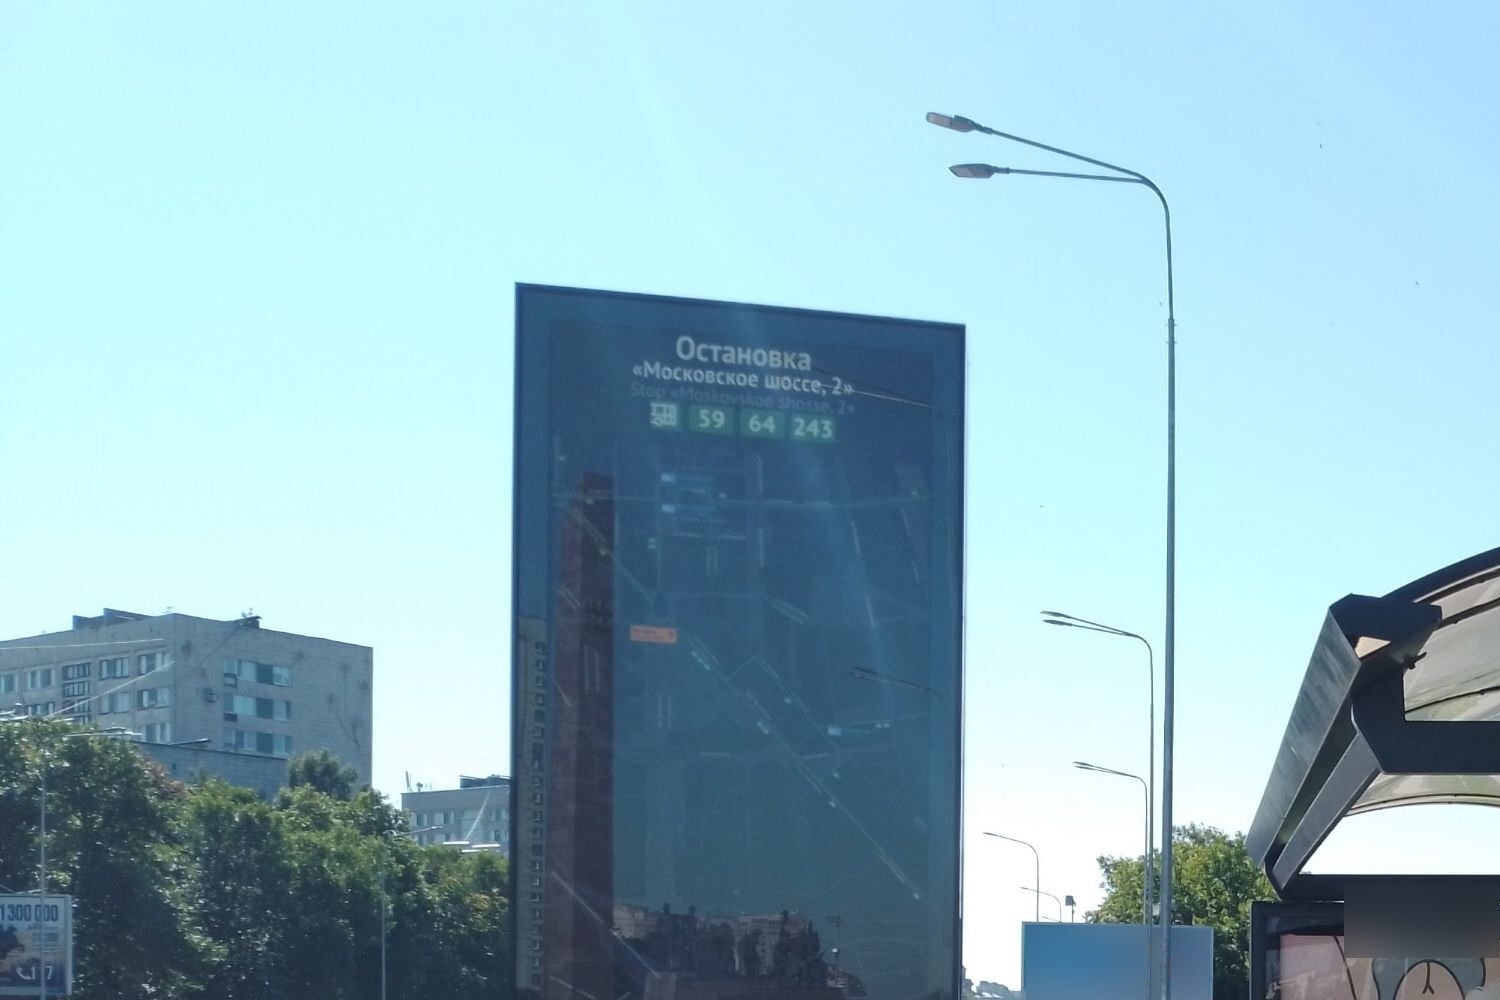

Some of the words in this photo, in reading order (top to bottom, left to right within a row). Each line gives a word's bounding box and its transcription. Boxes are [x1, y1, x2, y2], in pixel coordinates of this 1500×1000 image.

[676, 336, 812, 371] Остановка
[631, 382, 665, 399] Stop
[633, 361, 759, 388] «Московское
[765, 374, 827, 396] шоссе,
[832, 376, 854, 396] 2»
[698, 408, 725, 429] 59
[749, 413, 776, 433] 64
[792, 418, 833, 439] 243
[8, 904, 31, 921] 300
